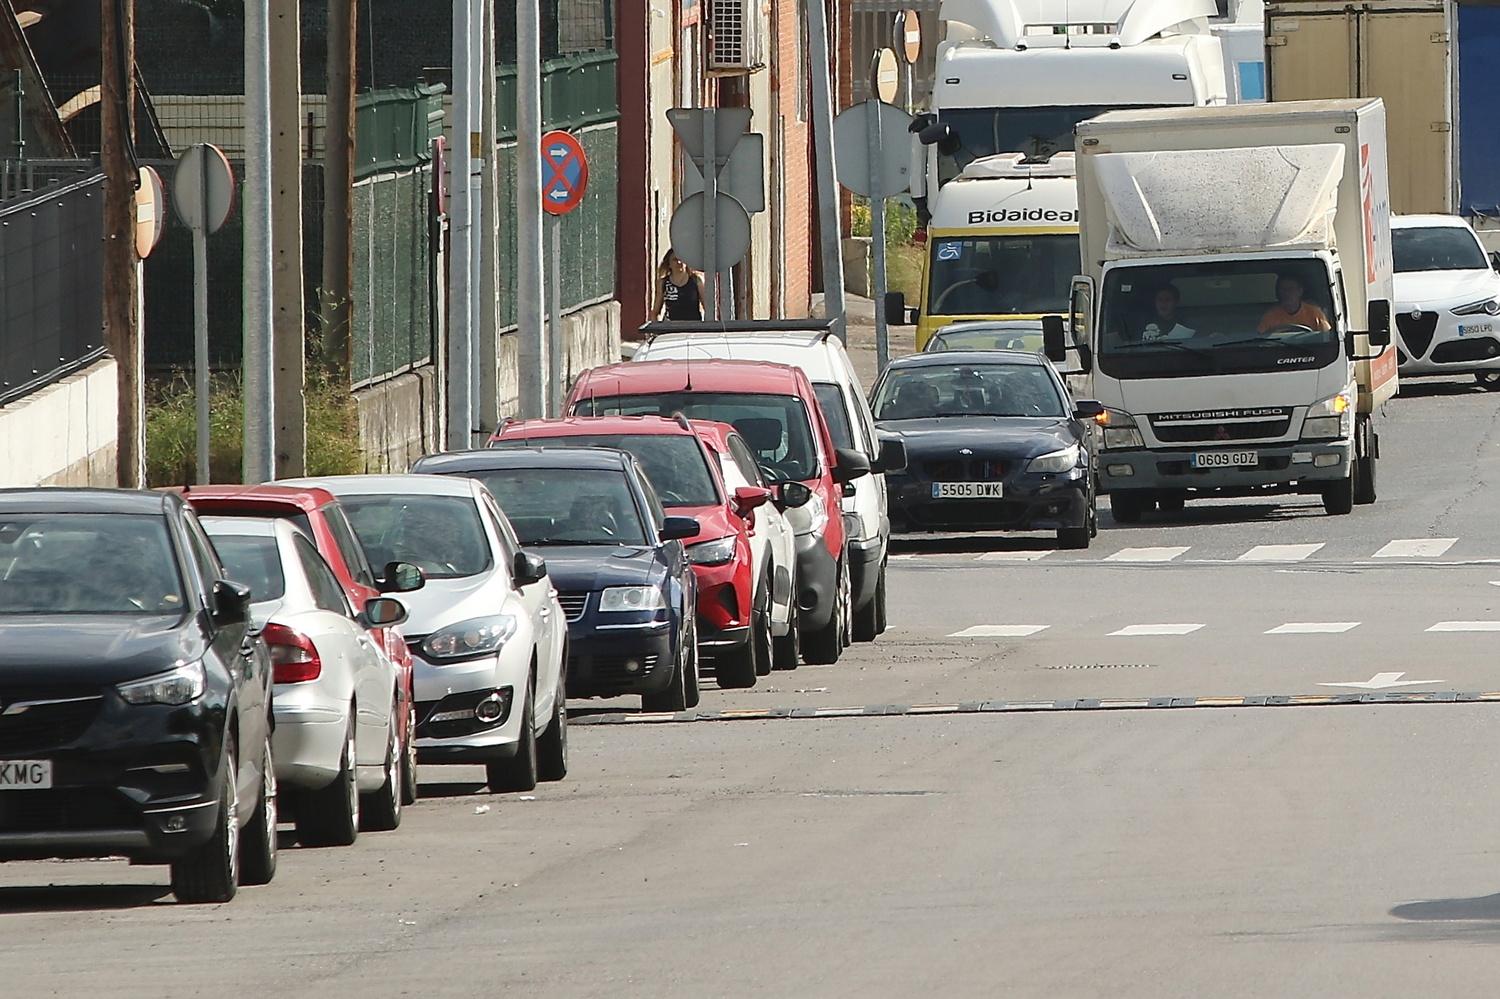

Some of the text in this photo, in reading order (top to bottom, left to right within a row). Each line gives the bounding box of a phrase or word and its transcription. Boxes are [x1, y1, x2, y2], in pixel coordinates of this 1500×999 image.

[1277, 356, 1316, 364] CANTER
[1158, 408, 1283, 421] MITSUBISHI FUSO
[1198, 452, 1256, 466] 0609 GDZ
[942, 484, 1000, 496] 5505 DWK
[0, 764, 43, 784] KMG
